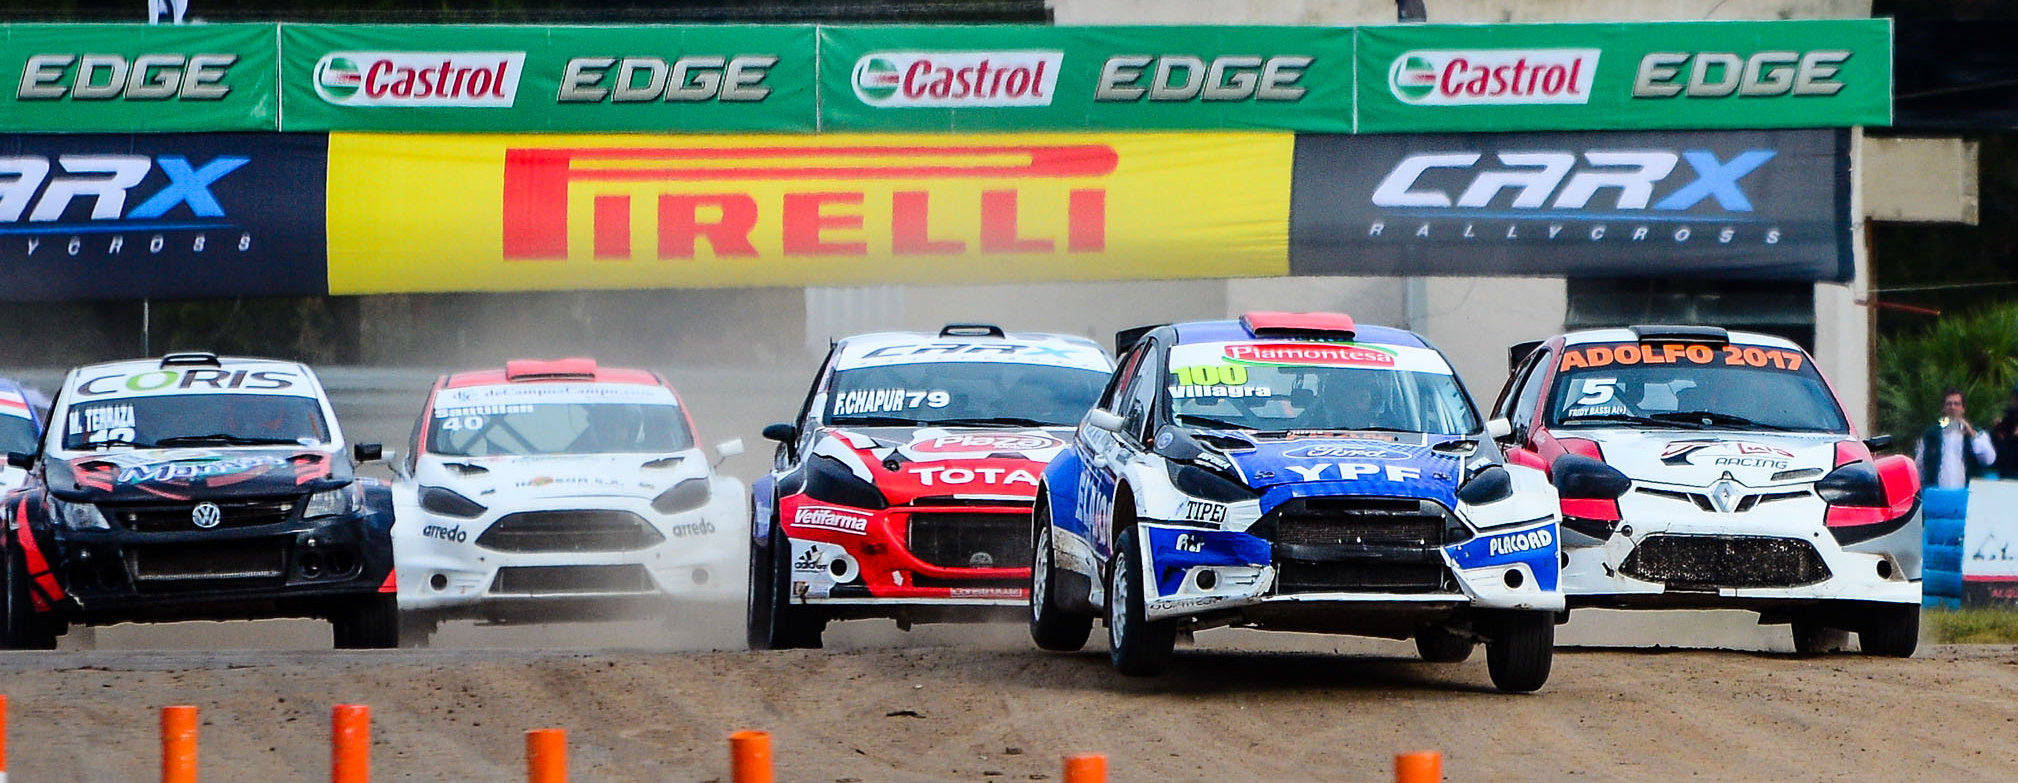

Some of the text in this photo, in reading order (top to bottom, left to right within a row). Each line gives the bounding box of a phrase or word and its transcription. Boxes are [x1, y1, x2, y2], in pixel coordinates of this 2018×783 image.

[17, 53, 238, 101] EDGE
[364, 58, 508, 100] Castrol
[557, 55, 779, 103] EDGE
[900, 58, 1047, 101] Castrol
[1093, 54, 1316, 102] EDGE
[1438, 56, 1583, 98] Castrol
[1631, 50, 1854, 99] EDGE
[1371, 149, 1778, 212] CARX
[503, 143, 1119, 261] PIRELLI
[1369, 222, 1782, 245] RALLYCROSS
[862, 342, 1082, 360] CARX
[1231, 344, 1393, 363] Piamontesa
[1560, 343, 1803, 373] ADOLFO 2017
[77, 369, 298, 396] CORIS
[1170, 364, 1249, 387] 100
[832, 388, 950, 416] F.CHAPUR 79
[1168, 383, 1273, 399] Villagra
[1577, 377, 1617, 405] 5
[442, 416, 484, 431] 40
[1306, 445, 1387, 458] Ford
[908, 466, 1039, 487] TOTA
[1285, 463, 1422, 483] YPF
[672, 519, 716, 538] arredo
[795, 508, 868, 531] Vetifarma
[422, 524, 467, 544] arredo
[1489, 530, 1553, 557] PLACORD
